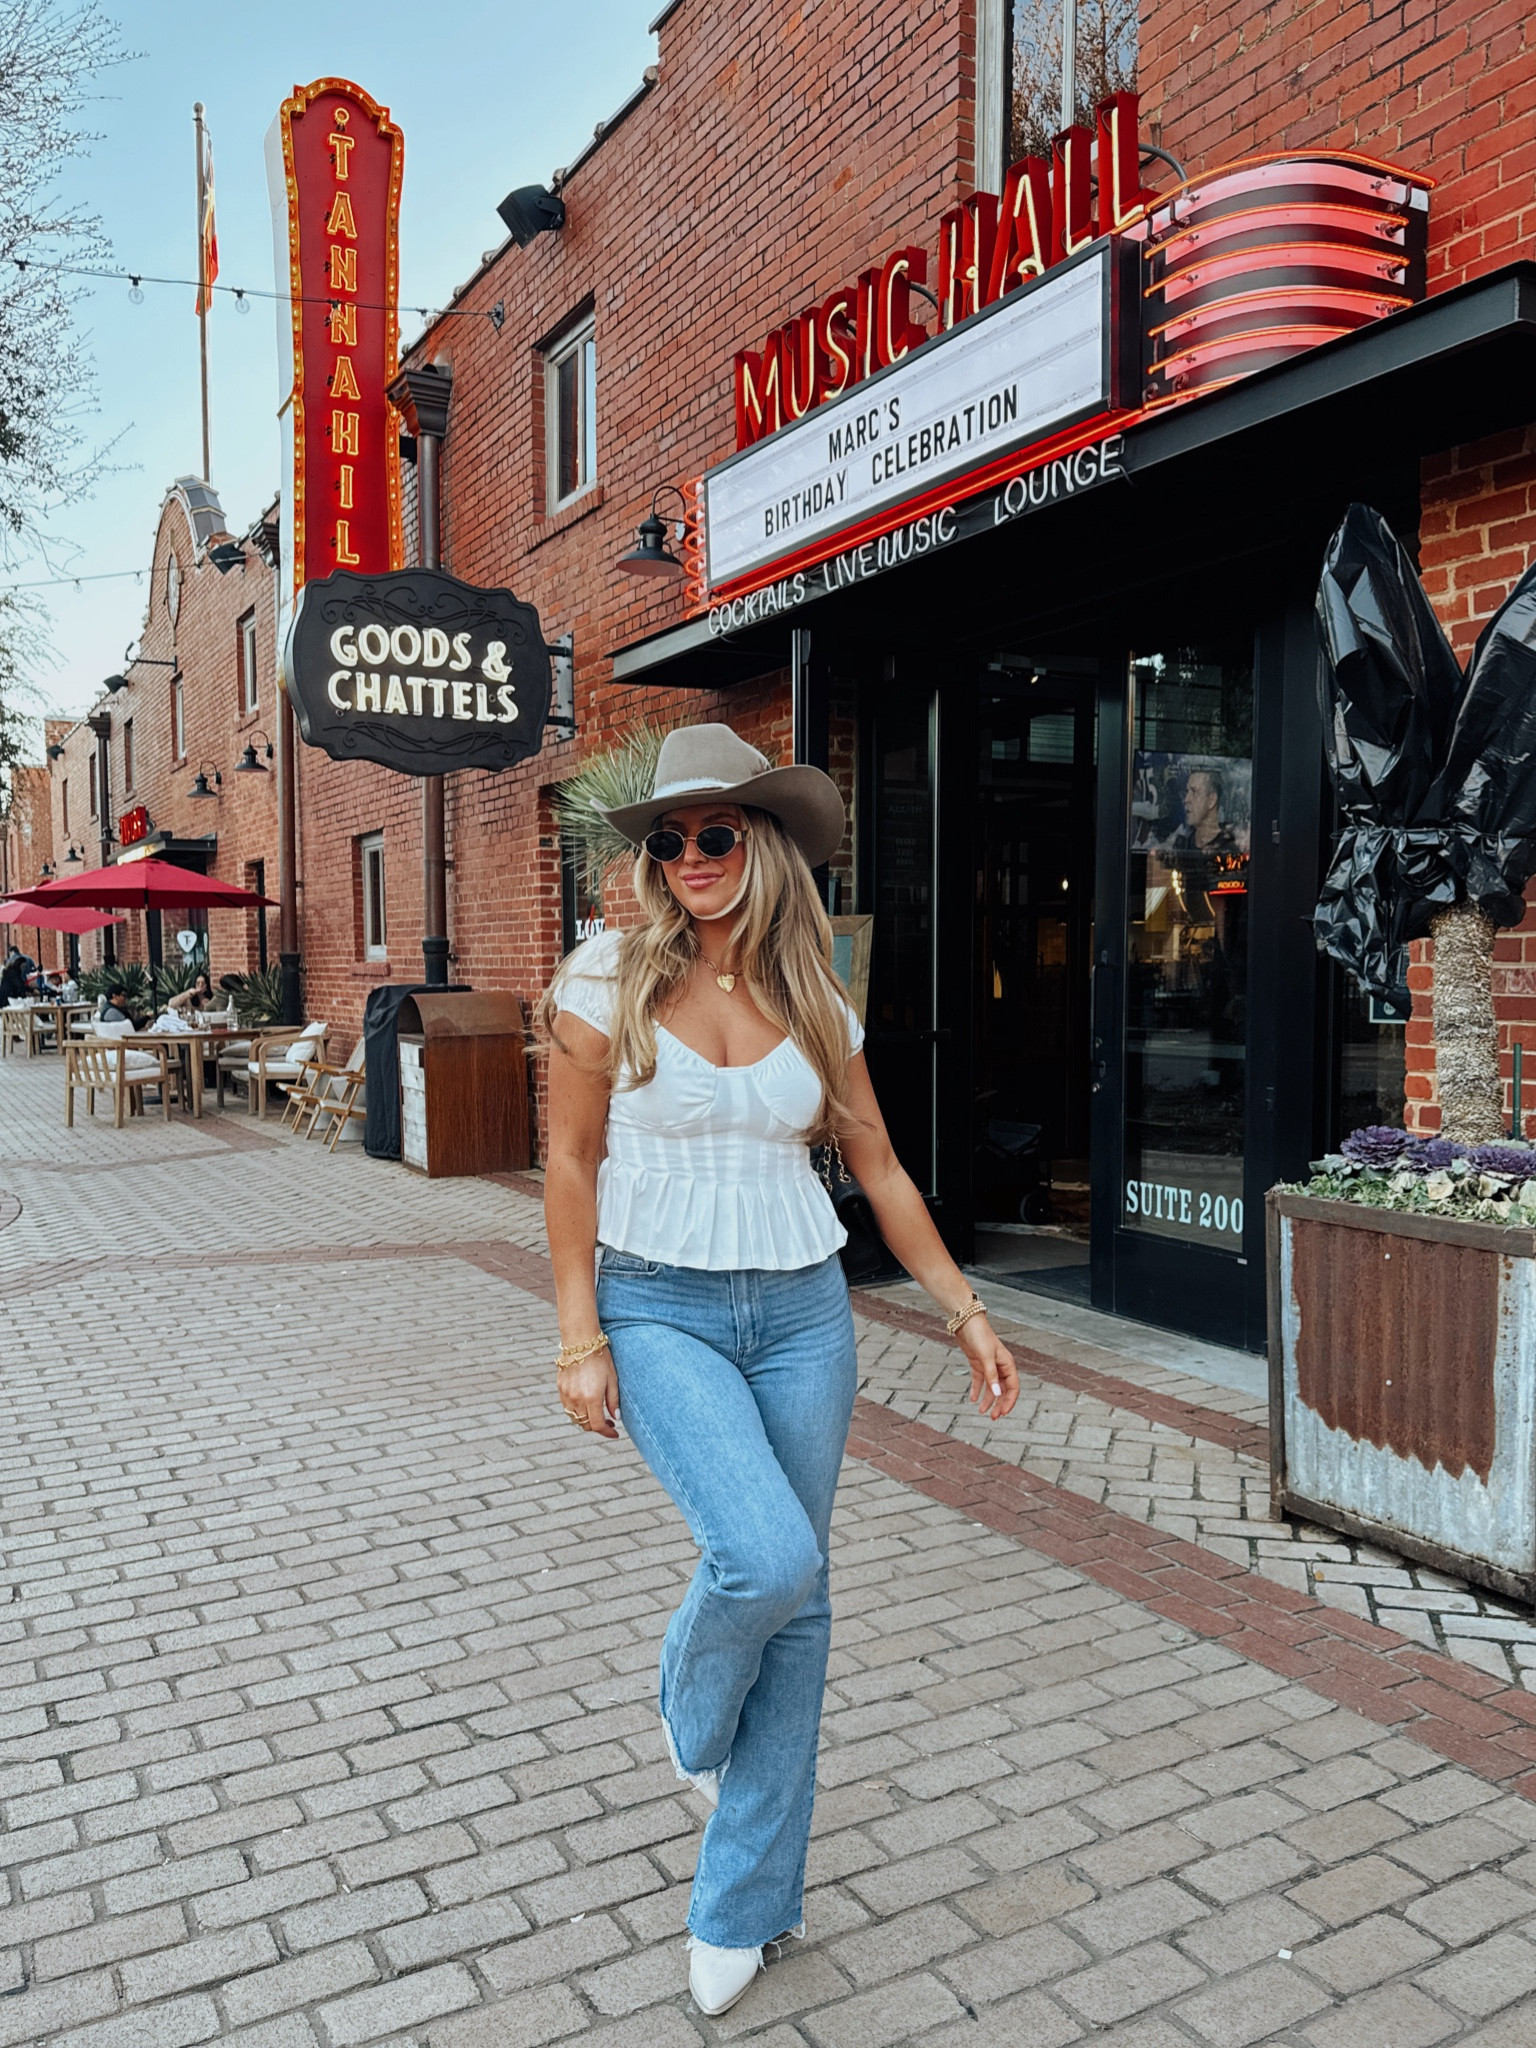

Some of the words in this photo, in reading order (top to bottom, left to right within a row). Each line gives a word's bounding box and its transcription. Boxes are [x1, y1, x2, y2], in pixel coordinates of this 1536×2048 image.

[735, 245, 928, 452] MUSIC
[936, 90, 1164, 336] HALL
[764, 468, 847, 538] BIRTHDAY
[872, 384, 1018, 486] CELEBRATION
[828, 396, 900, 464] MARC'S
[707, 572, 806, 636] COCKTAILS
[823, 542, 878, 592] LIVE
[877, 506, 957, 568] MUSIC
[994, 434, 1123, 526] LOUNGE
[329, 623, 473, 672] GOODS
[480, 640, 514, 684] &
[326, 669, 521, 724] CHATTELS
[1125, 1179, 1193, 1225] SUITE
[1199, 1191, 1245, 1234] 200
